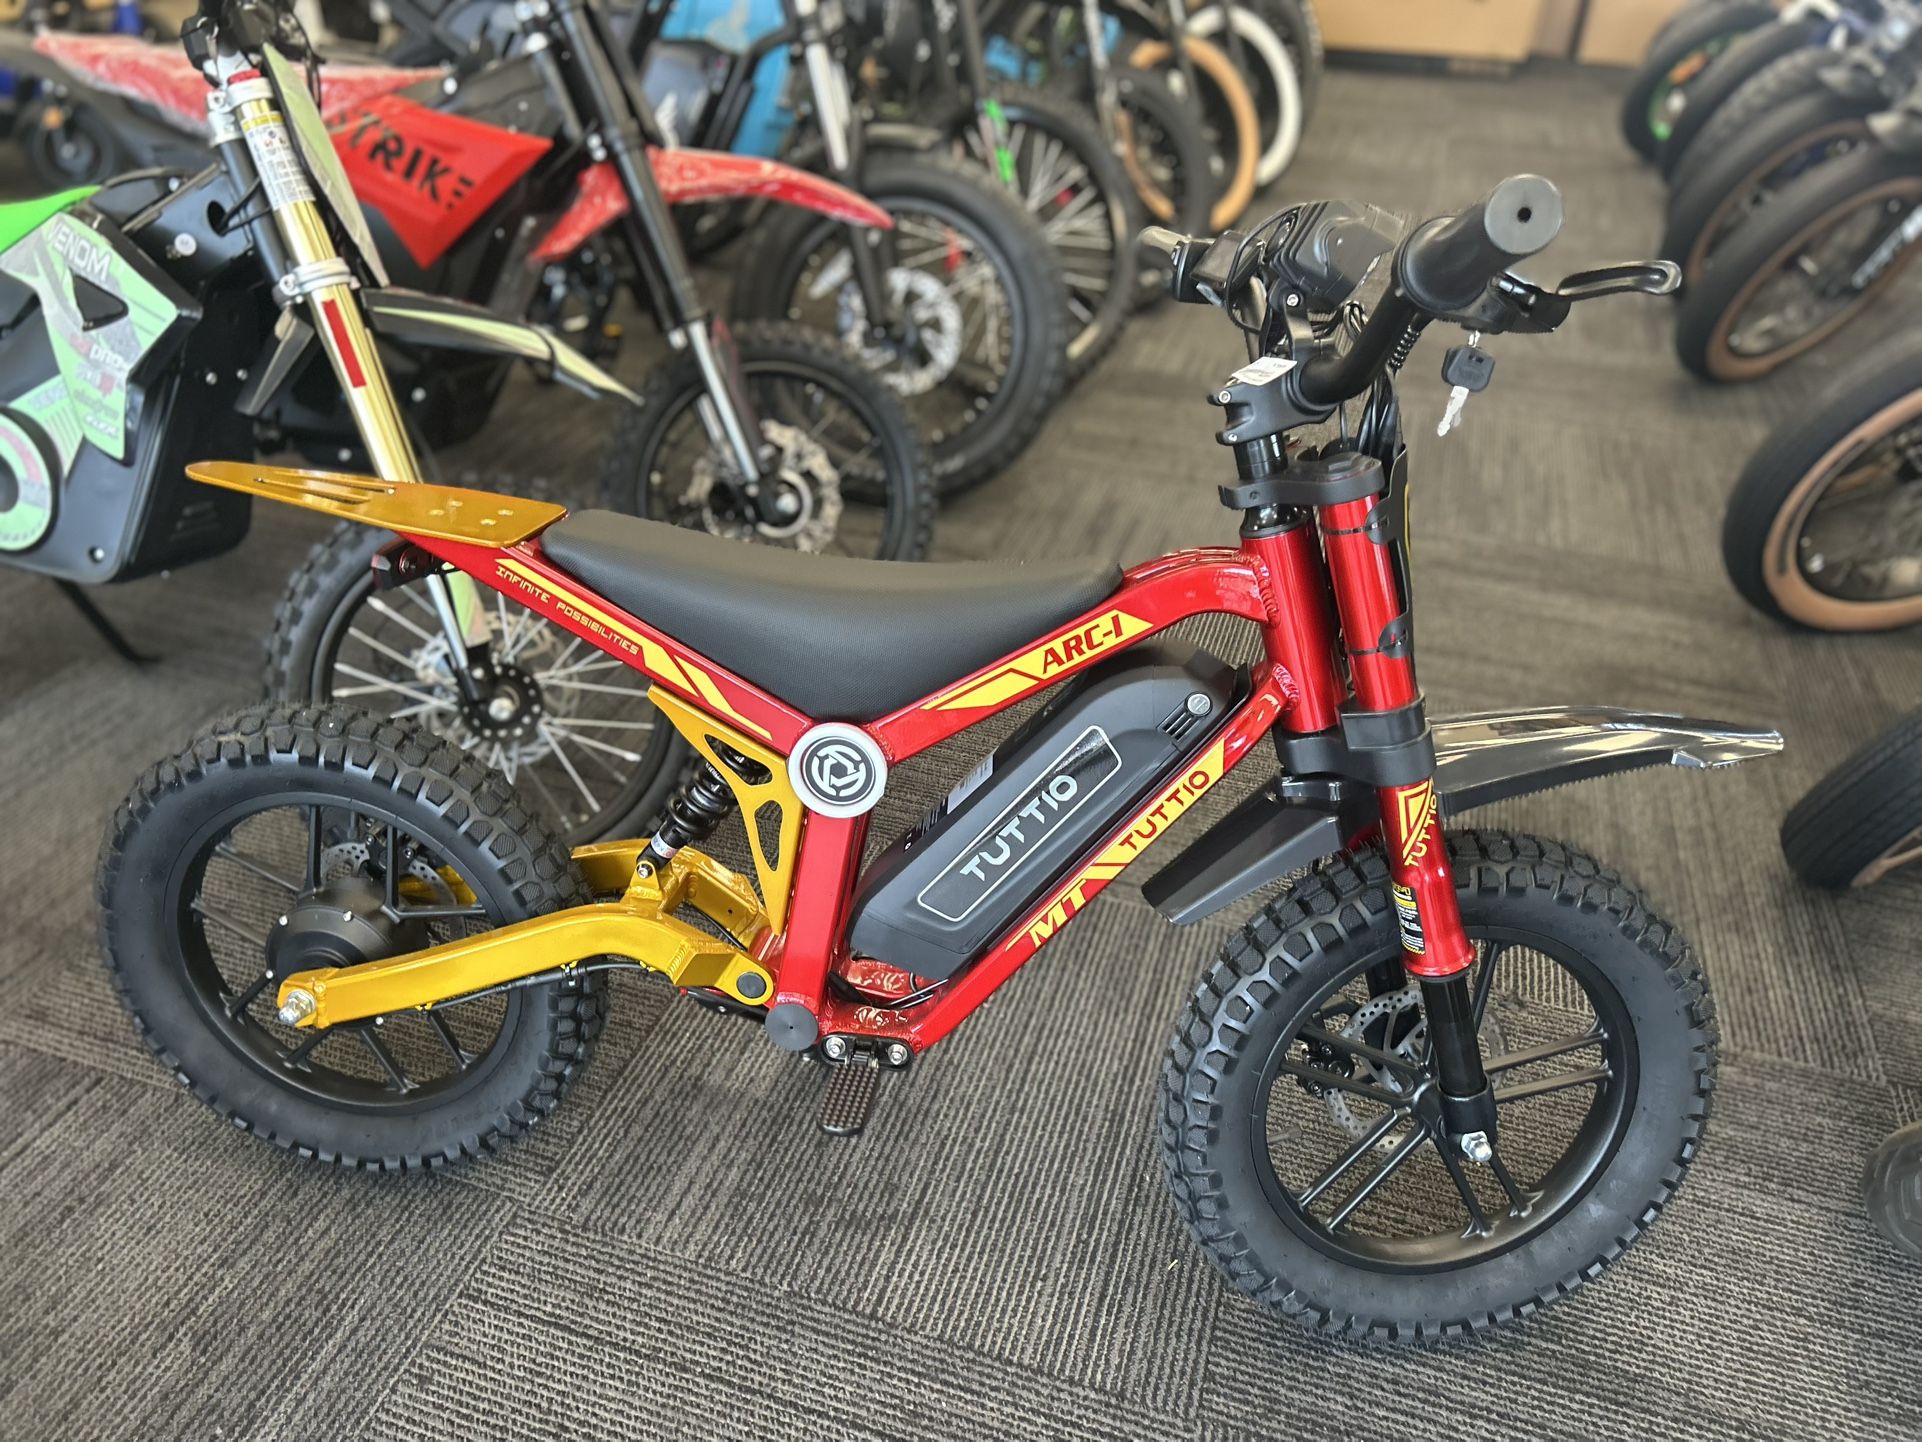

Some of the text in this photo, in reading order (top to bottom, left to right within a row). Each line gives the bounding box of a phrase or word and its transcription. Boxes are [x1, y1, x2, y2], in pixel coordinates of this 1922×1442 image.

[46, 219, 112, 283] VENOM
[496, 565, 640, 656] INFINITE POSSIBILITIES
[960, 774, 1078, 882] TUTTIO
[1028, 770, 1210, 948] MT TUTTIO
[1404, 794, 1437, 867] TUTTIO
